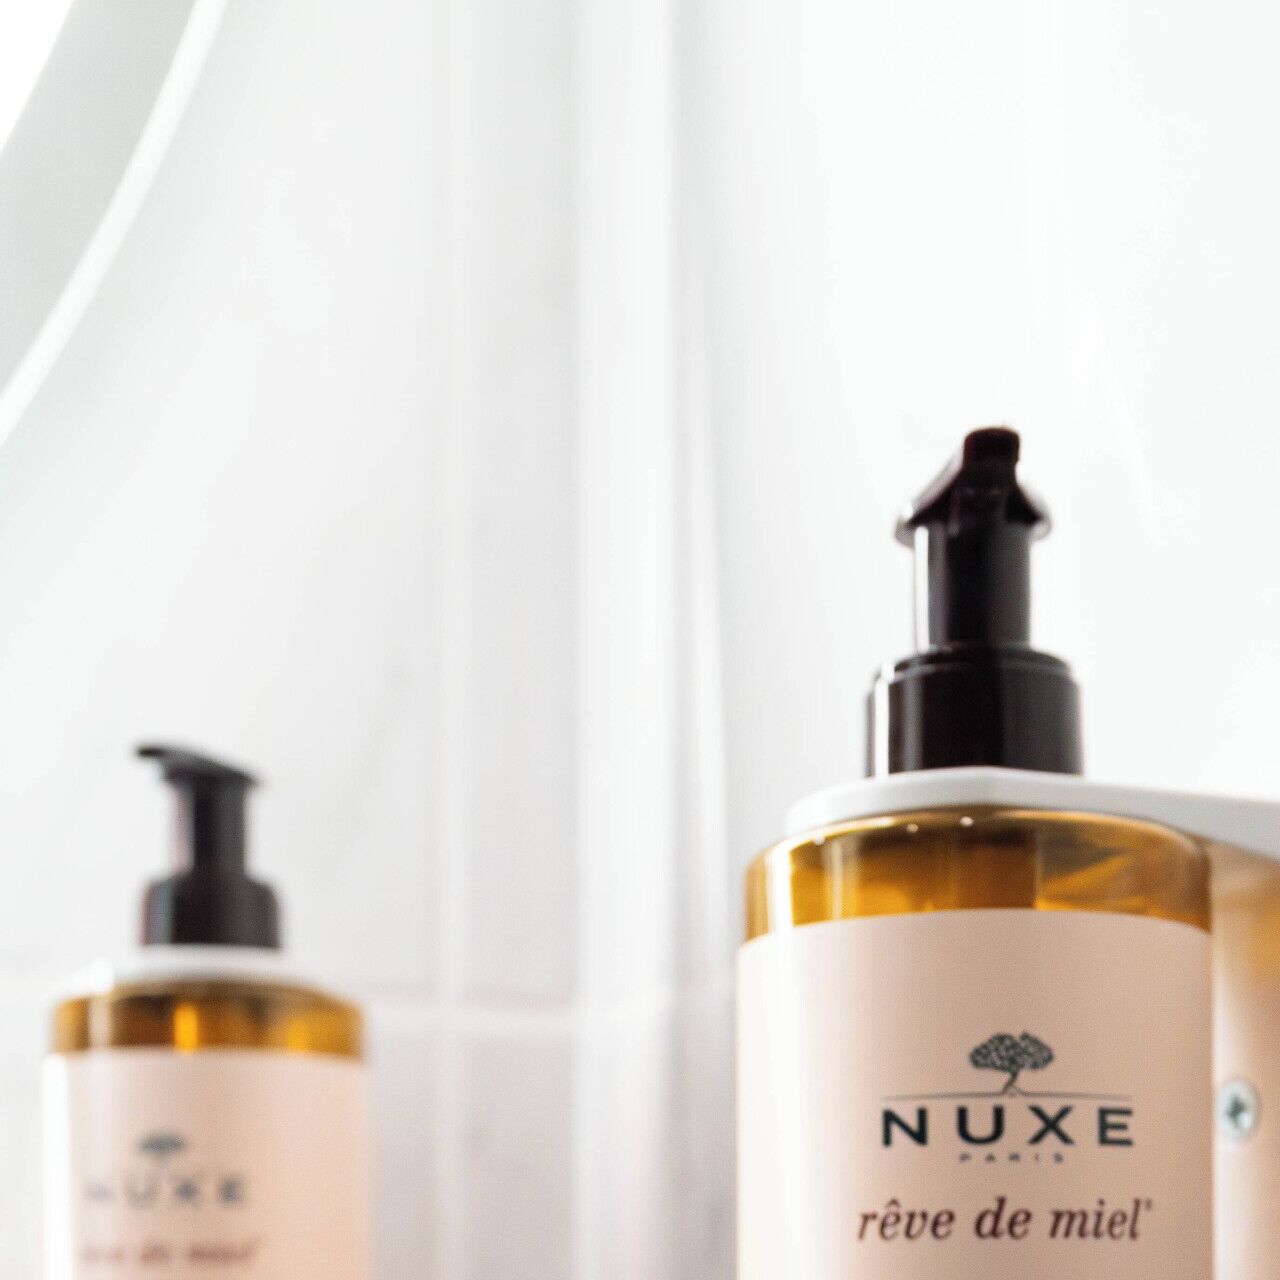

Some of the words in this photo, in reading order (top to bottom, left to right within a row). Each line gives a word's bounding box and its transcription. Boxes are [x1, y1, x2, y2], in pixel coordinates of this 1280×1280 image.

[880, 1104, 1135, 1148] NUXE
[857, 1199, 955, 1241] rêve
[973, 1196, 1032, 1240] de
